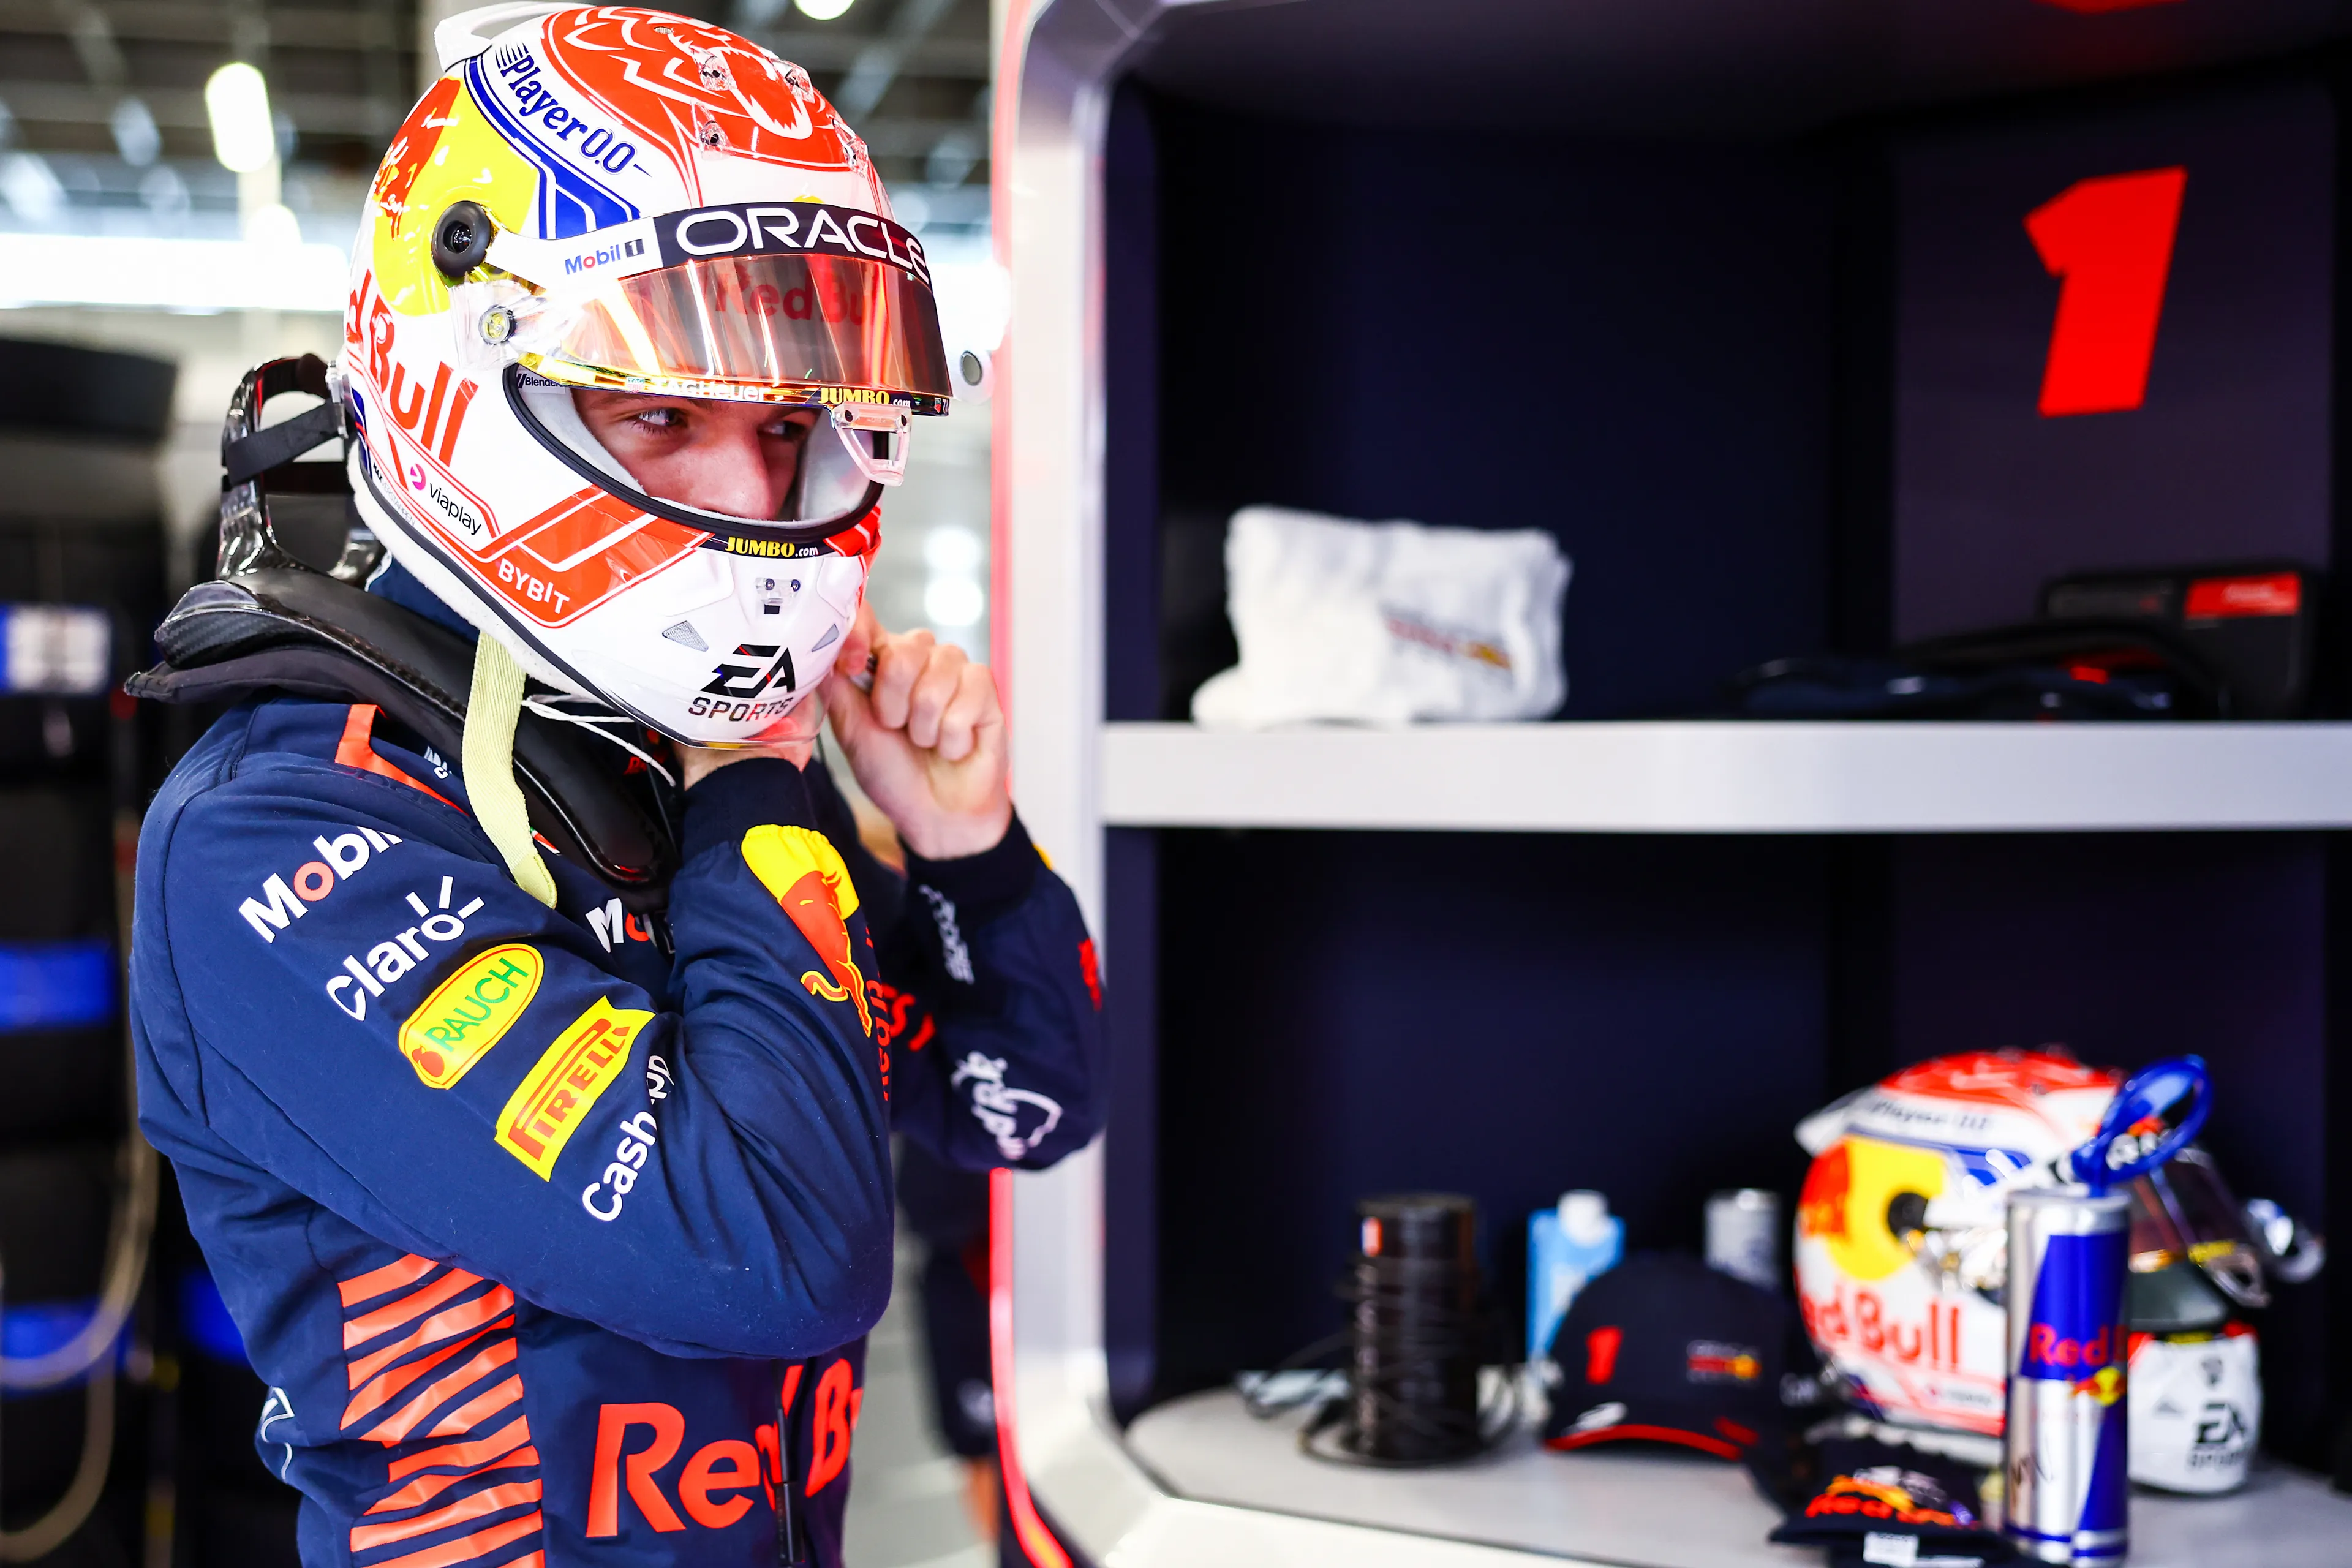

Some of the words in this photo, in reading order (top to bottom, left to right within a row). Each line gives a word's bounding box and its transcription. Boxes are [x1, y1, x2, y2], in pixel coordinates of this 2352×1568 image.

[500, 54, 588, 141] Player
[579, 127, 637, 174] 0.0
[565, 244, 621, 275] Mobil
[676, 208, 929, 284] ORACLE
[2022, 164, 2188, 419] 1
[369, 294, 479, 467] Bull
[429, 482, 482, 536] viaplay
[499, 558, 570, 614] BYBIT
[700, 644, 796, 699] EA
[688, 696, 794, 722] SPORTS
[424, 957, 529, 1052] RAUCH
[582, 1110, 657, 1222] Cash
[1586, 1326, 1622, 1385] 1
[1855, 1291, 1960, 1373] Bull
[2029, 1322, 2109, 1367] Red
